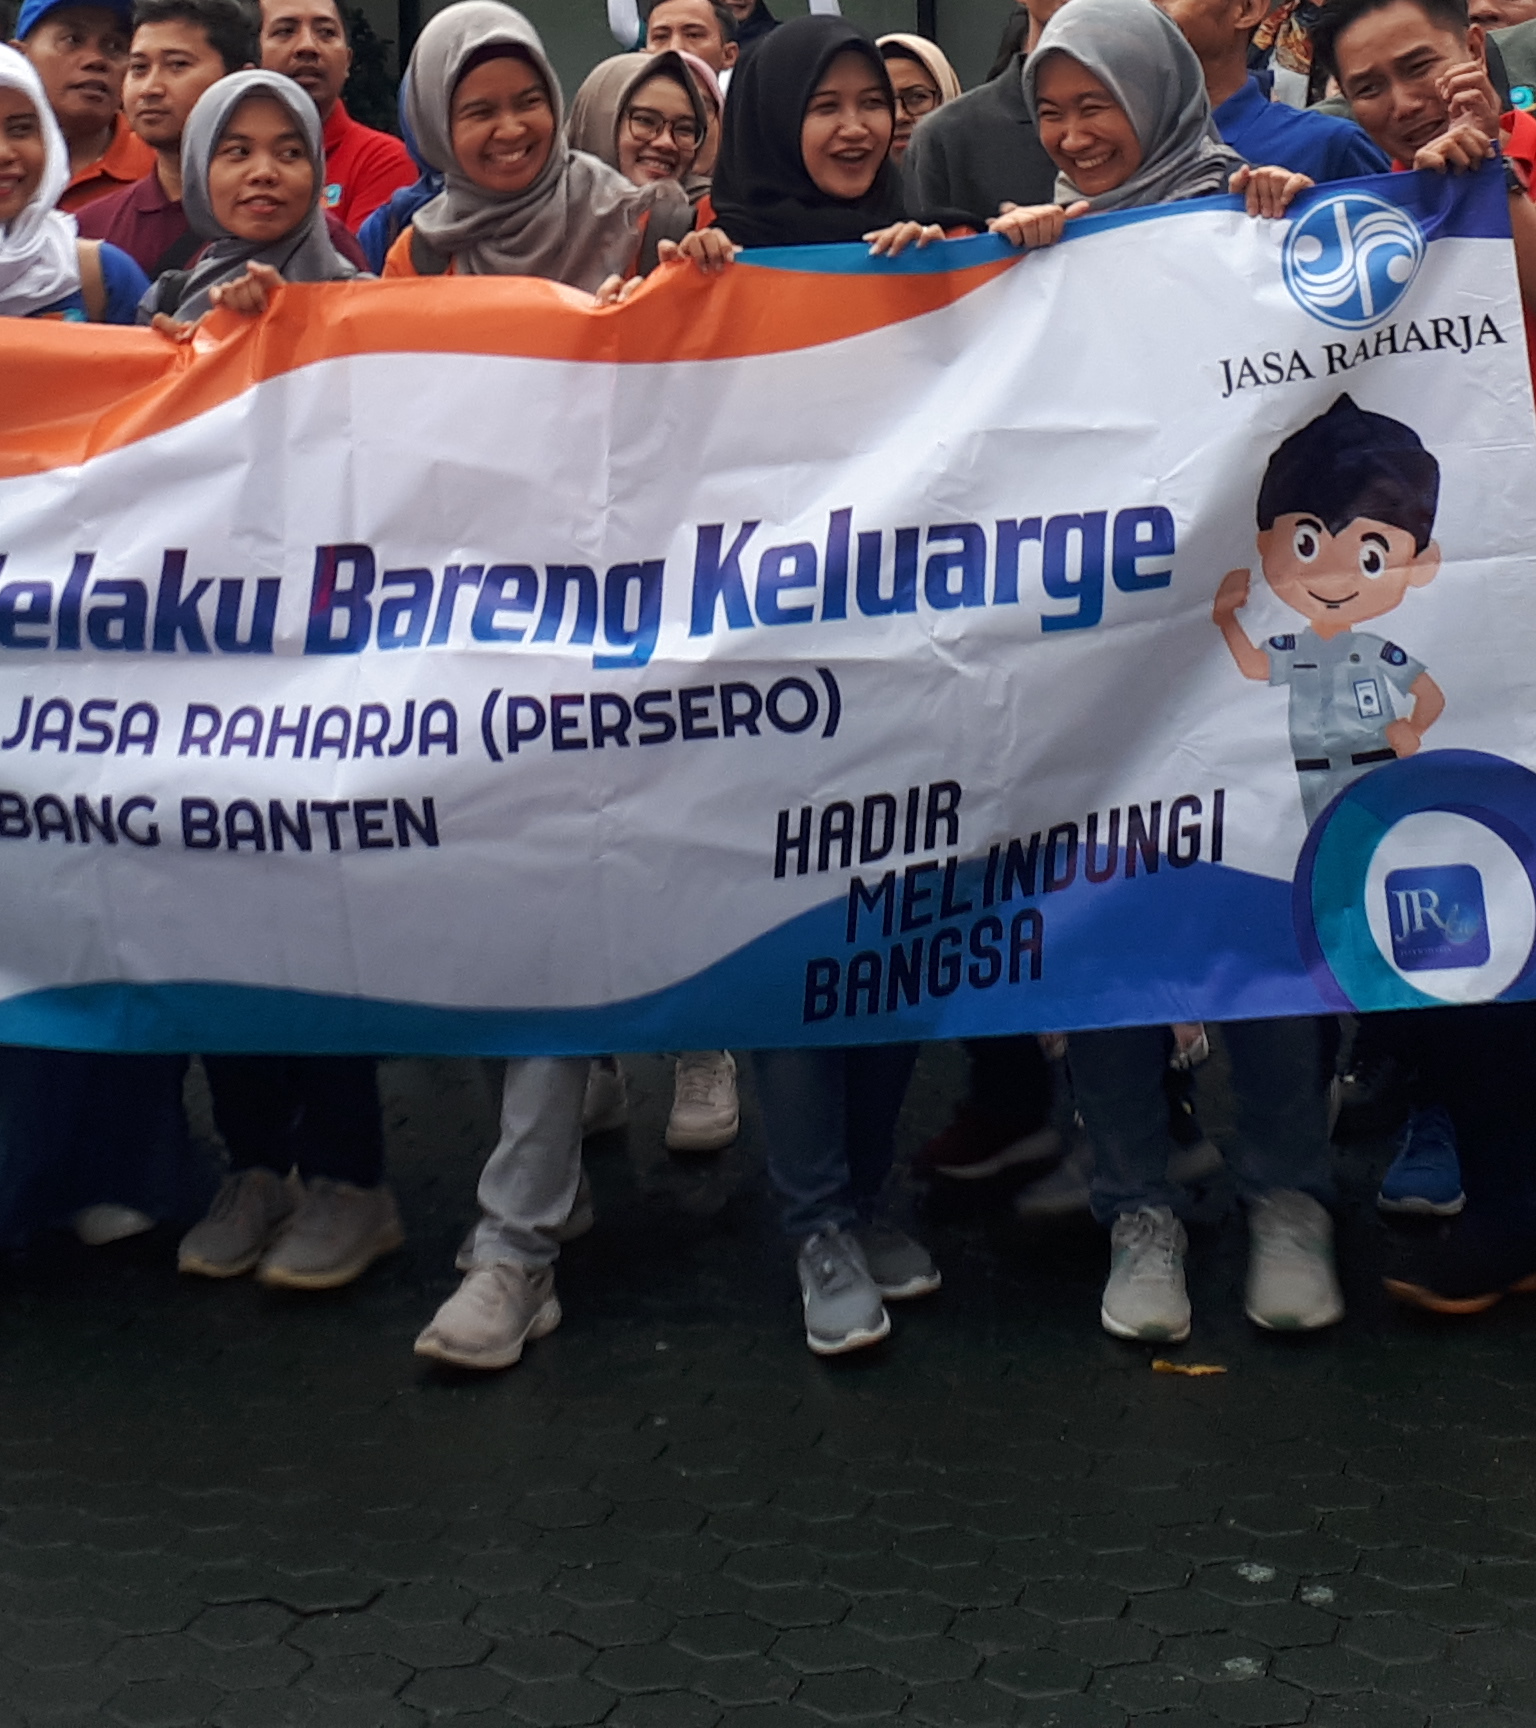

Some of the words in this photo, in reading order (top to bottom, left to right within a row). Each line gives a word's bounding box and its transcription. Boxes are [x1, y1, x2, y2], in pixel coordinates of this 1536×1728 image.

[1219, 347, 1314, 398] JASA
[1324, 313, 1509, 377] RAHARJA
[304, 542, 667, 669] Bareng
[687, 505, 1177, 639] Keluarge
[0, 696, 160, 756] JASA
[177, 697, 459, 760] RAHARJA
[480, 666, 843, 763] (PERSERO)
[180, 796, 440, 852] BANTEN
[772, 780, 963, 880] HADIR
[800, 908, 1045, 1026] BANGSA
